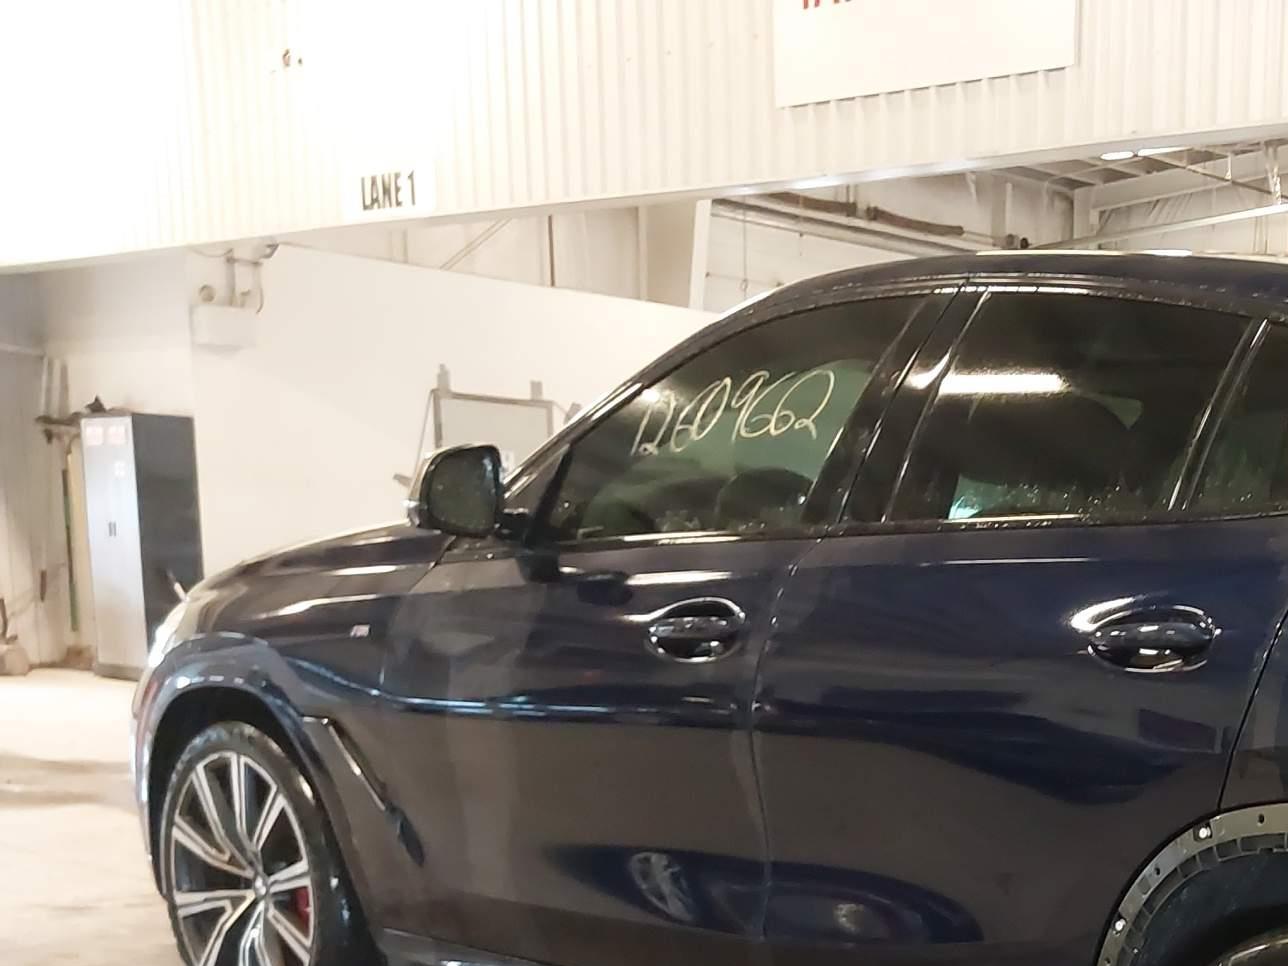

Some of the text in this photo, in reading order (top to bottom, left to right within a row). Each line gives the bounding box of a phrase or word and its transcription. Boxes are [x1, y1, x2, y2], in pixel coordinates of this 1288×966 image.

[360, 169, 416, 211] LANE 1
[630, 369, 836, 457] 12609662
